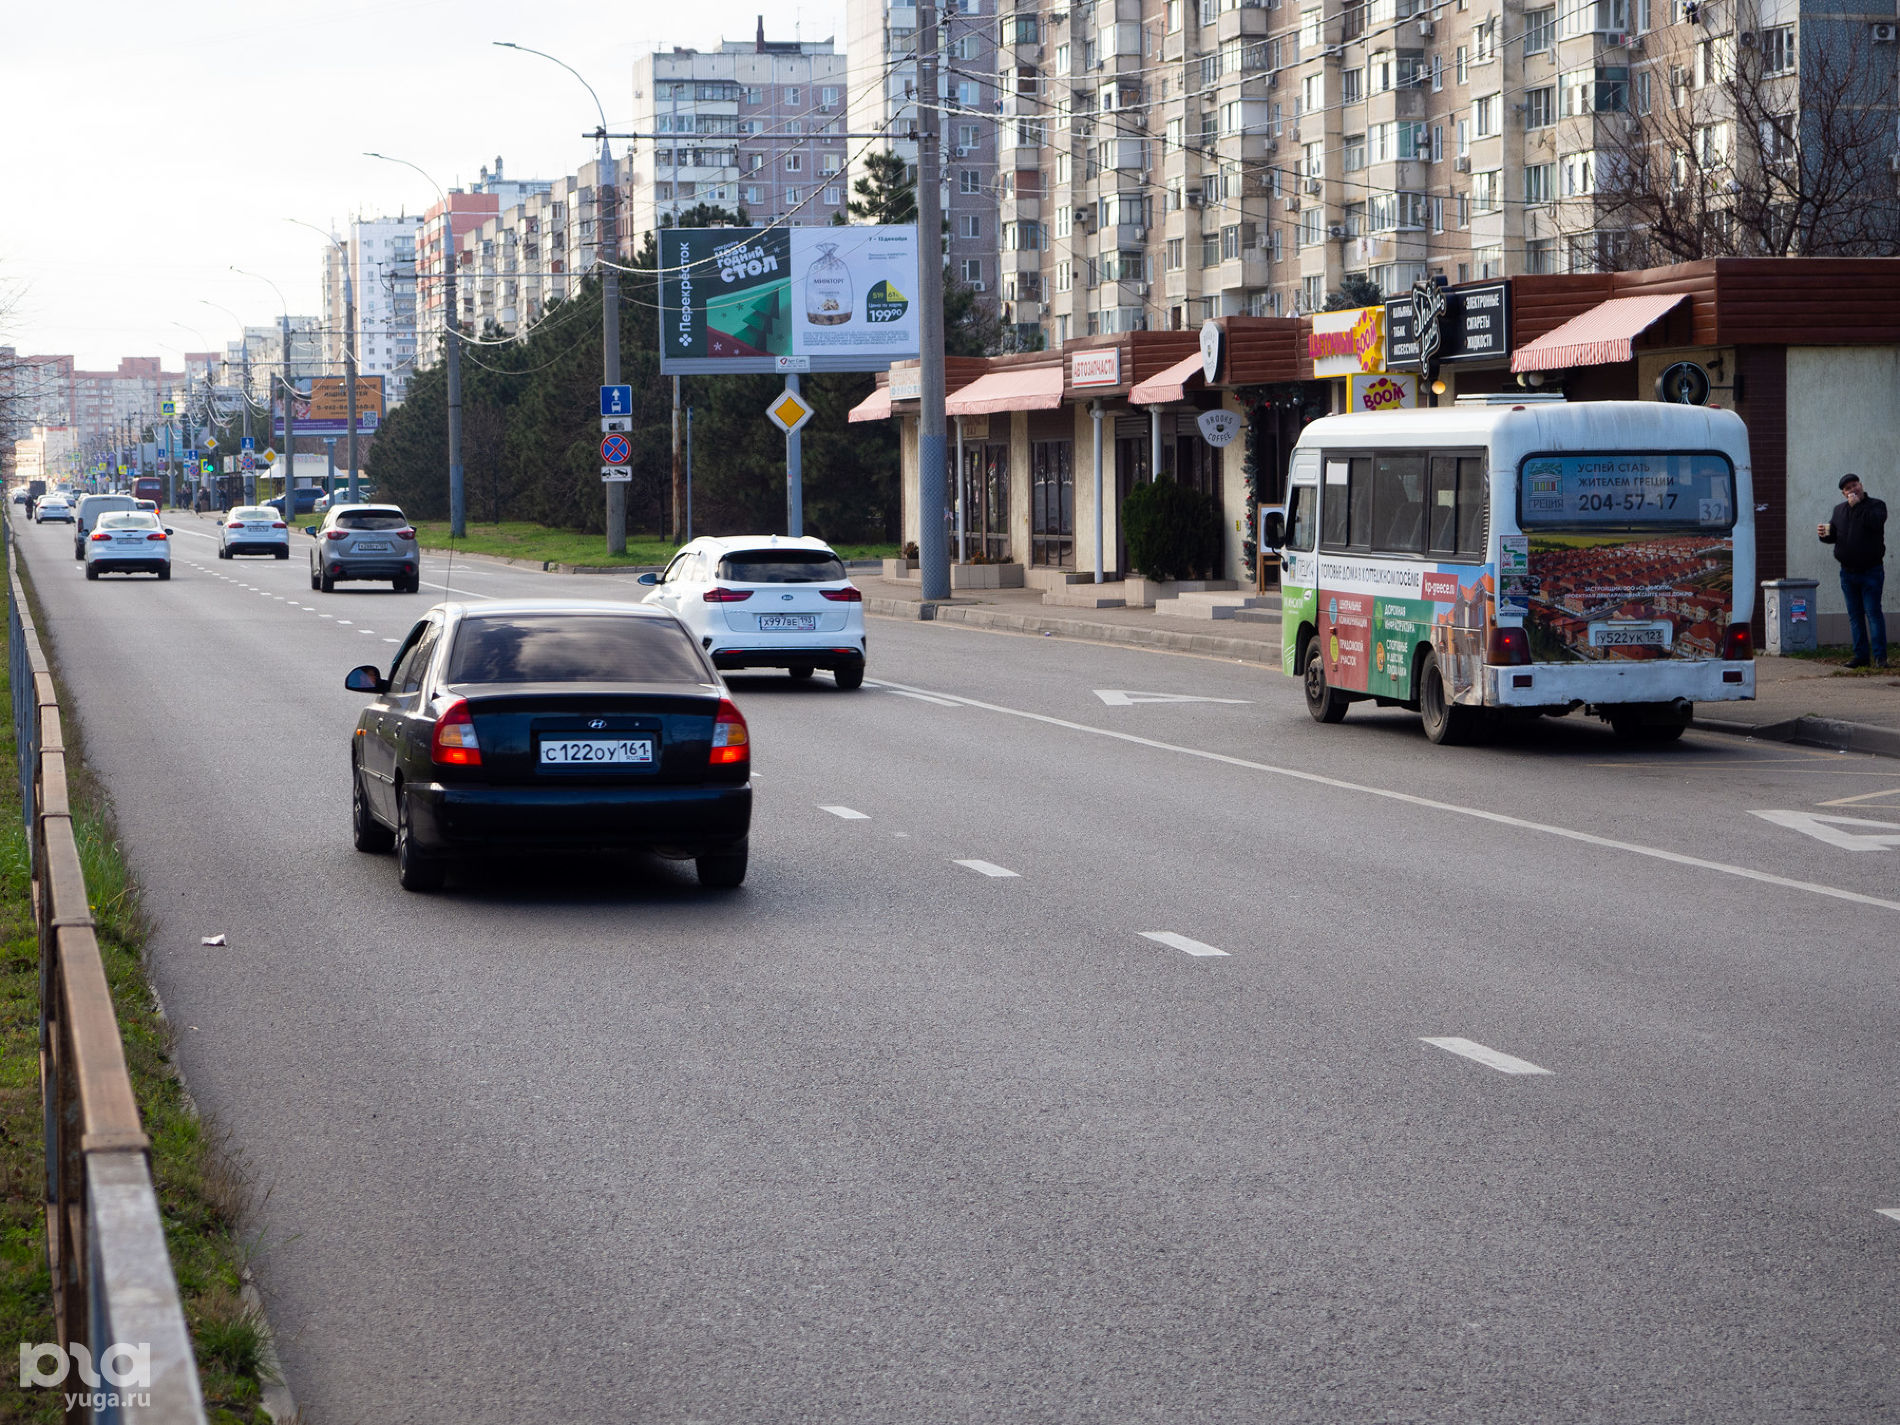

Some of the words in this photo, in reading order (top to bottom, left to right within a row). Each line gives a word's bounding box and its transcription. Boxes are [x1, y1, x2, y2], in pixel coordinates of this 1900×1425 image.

[678, 241, 693, 332] Перекрёсток
[1466, 293, 1500, 311] ЭЛЕКТРОННЫЕ
[1466, 315, 1491, 331] СИГАРЕТЫ
[1308, 327, 1354, 359] ЦВЕТОЧНЫЙ
[1356, 320, 1377, 357] BOOM
[1466, 333, 1493, 351] ЖИДКОСТИ
[1074, 359, 1115, 377] АВТОЗАПЧАСТИ
[1362, 386, 1405, 409] BOOM
[1205, 414, 1233, 426] BROOKS
[1207, 431, 1233, 443] COFFEE
[1577, 462, 1615, 473] УСПЕЙ
[1617, 463, 1650, 473] СТАТЬ
[1578, 476, 1631, 488] ЖИТЕЛЕМ
[1633, 476, 1675, 488] ГРЕЦИИ
[1529, 498, 1564, 509] ГРЕЦИЯ
[1578, 493, 1678, 512] 204-57-17
[1701, 502, 1724, 522] 32
[545, 743, 617, 761] С122ОУ
[620, 742, 648, 756] 161
